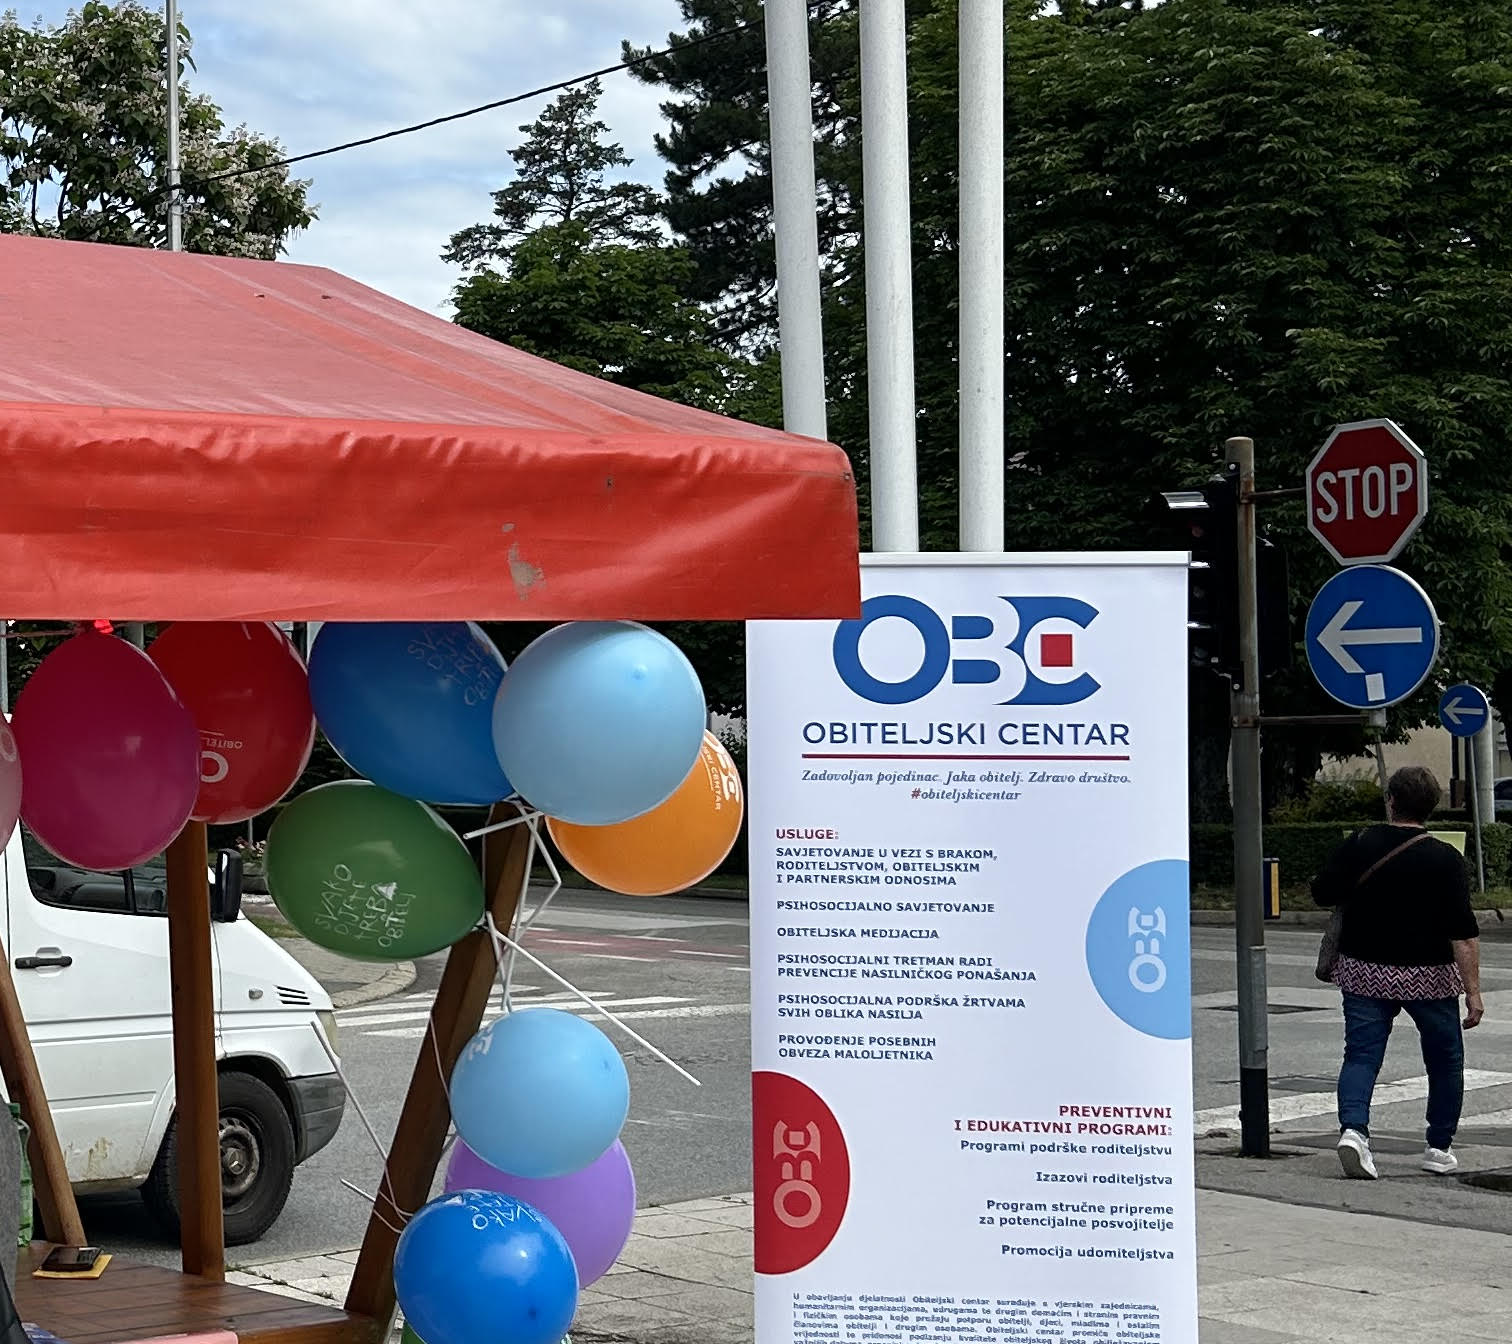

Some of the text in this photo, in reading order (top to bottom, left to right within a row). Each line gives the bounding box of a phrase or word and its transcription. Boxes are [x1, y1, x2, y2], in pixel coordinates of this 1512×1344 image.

[1316, 462, 1413, 523] STOP
[833, 595, 1101, 706] OBC
[802, 722, 1130, 746] OBITELJSKI CENTAR
[802, 769, 873, 784] Zadovoljan
[945, 770, 976, 785] Jaka
[979, 770, 1024, 786] obitelj.
[1029, 771, 1075, 784] Zdravo
[1079, 770, 1132, 784] društvo.
[911, 787, 1022, 802] #obiteljskicentar
[776, 829, 839, 840] USLUGE:
[776, 847, 998, 861] SAVJETOVANJE U VEZI S BRAKOM,
[776, 861, 980, 873] RODITELJSTVOM, OBITELJSKIM
[776, 874, 956, 886] I PARTNERSKIM ODNOSIMA
[777, 900, 995, 913] PSIHOSOCIJALNO SAVJETOVANJE
[777, 927, 939, 939] OBITELJSKA MEDIJACIJA
[1128, 905, 1167, 993] OBC
[777, 954, 993, 967] PSIHOSOCIJALNI TRETMAN RADI
[777, 966, 1037, 981] PREVENCIJE NASILNIČKOG PONAŠANJA
[778, 993, 1026, 1008] PSIHOSOCIJALNA PODRŠKA ŽRTVAMA
[778, 1008, 923, 1020] SVIH OBLIKA NASILJA
[868, 1036, 936, 1047] POSEBNIH
[778, 1048, 933, 1061] OBVEZA MALOLJETNIKA
[1059, 1105, 1172, 1119] PREVENTIVNI
[954, 1119, 1173, 1136] I EDUKATIVNI PROGRAMI:
[960, 1140, 1172, 1157] Programi podrške roditeljstvu
[773, 1120, 822, 1228] OBC
[1036, 1171, 1173, 1186] Izazovi roditeljstva
[987, 1200, 1173, 1216] Program stručne pripreme
[979, 1216, 1174, 1231] za potencijalne posvojitelje
[1001, 1244, 1174, 1261] Promocija udomiteljstva
